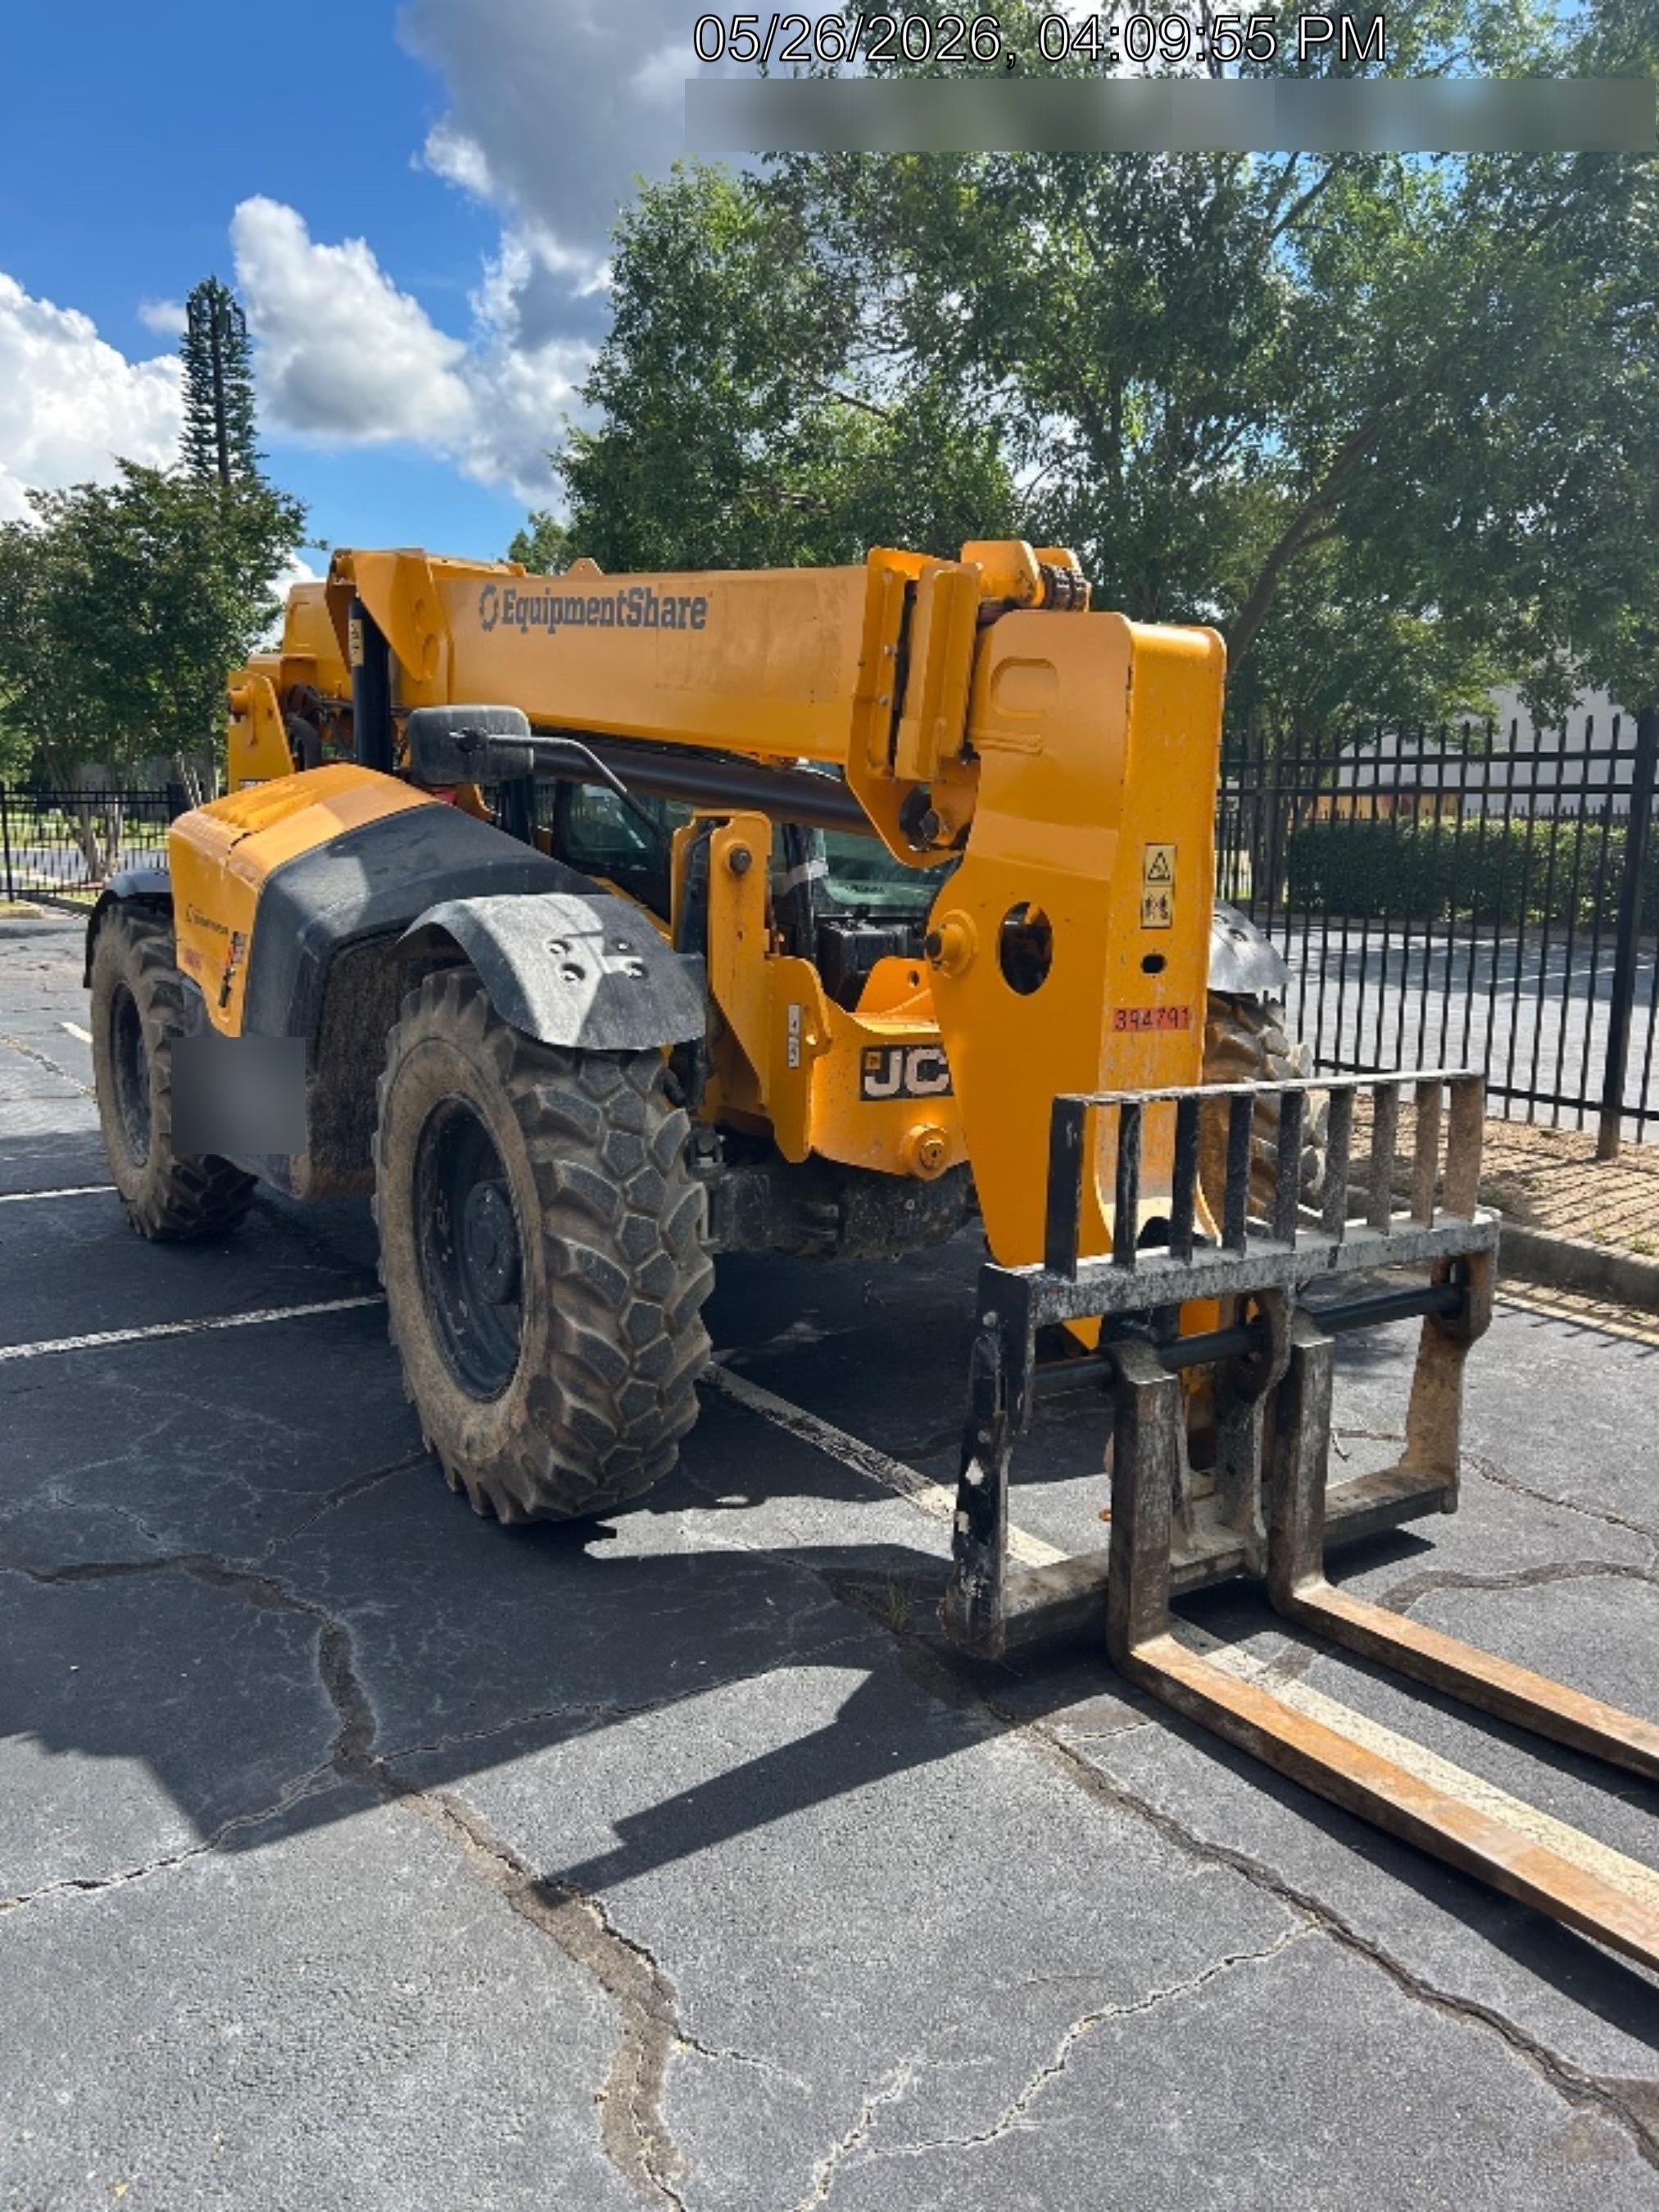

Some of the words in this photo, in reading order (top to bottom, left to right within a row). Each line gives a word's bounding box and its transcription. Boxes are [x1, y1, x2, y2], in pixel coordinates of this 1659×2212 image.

[502, 587, 708, 634] EquipmentShare
[1115, 1007, 1189, 1030] 394791
[864, 1048, 950, 1096] JC
